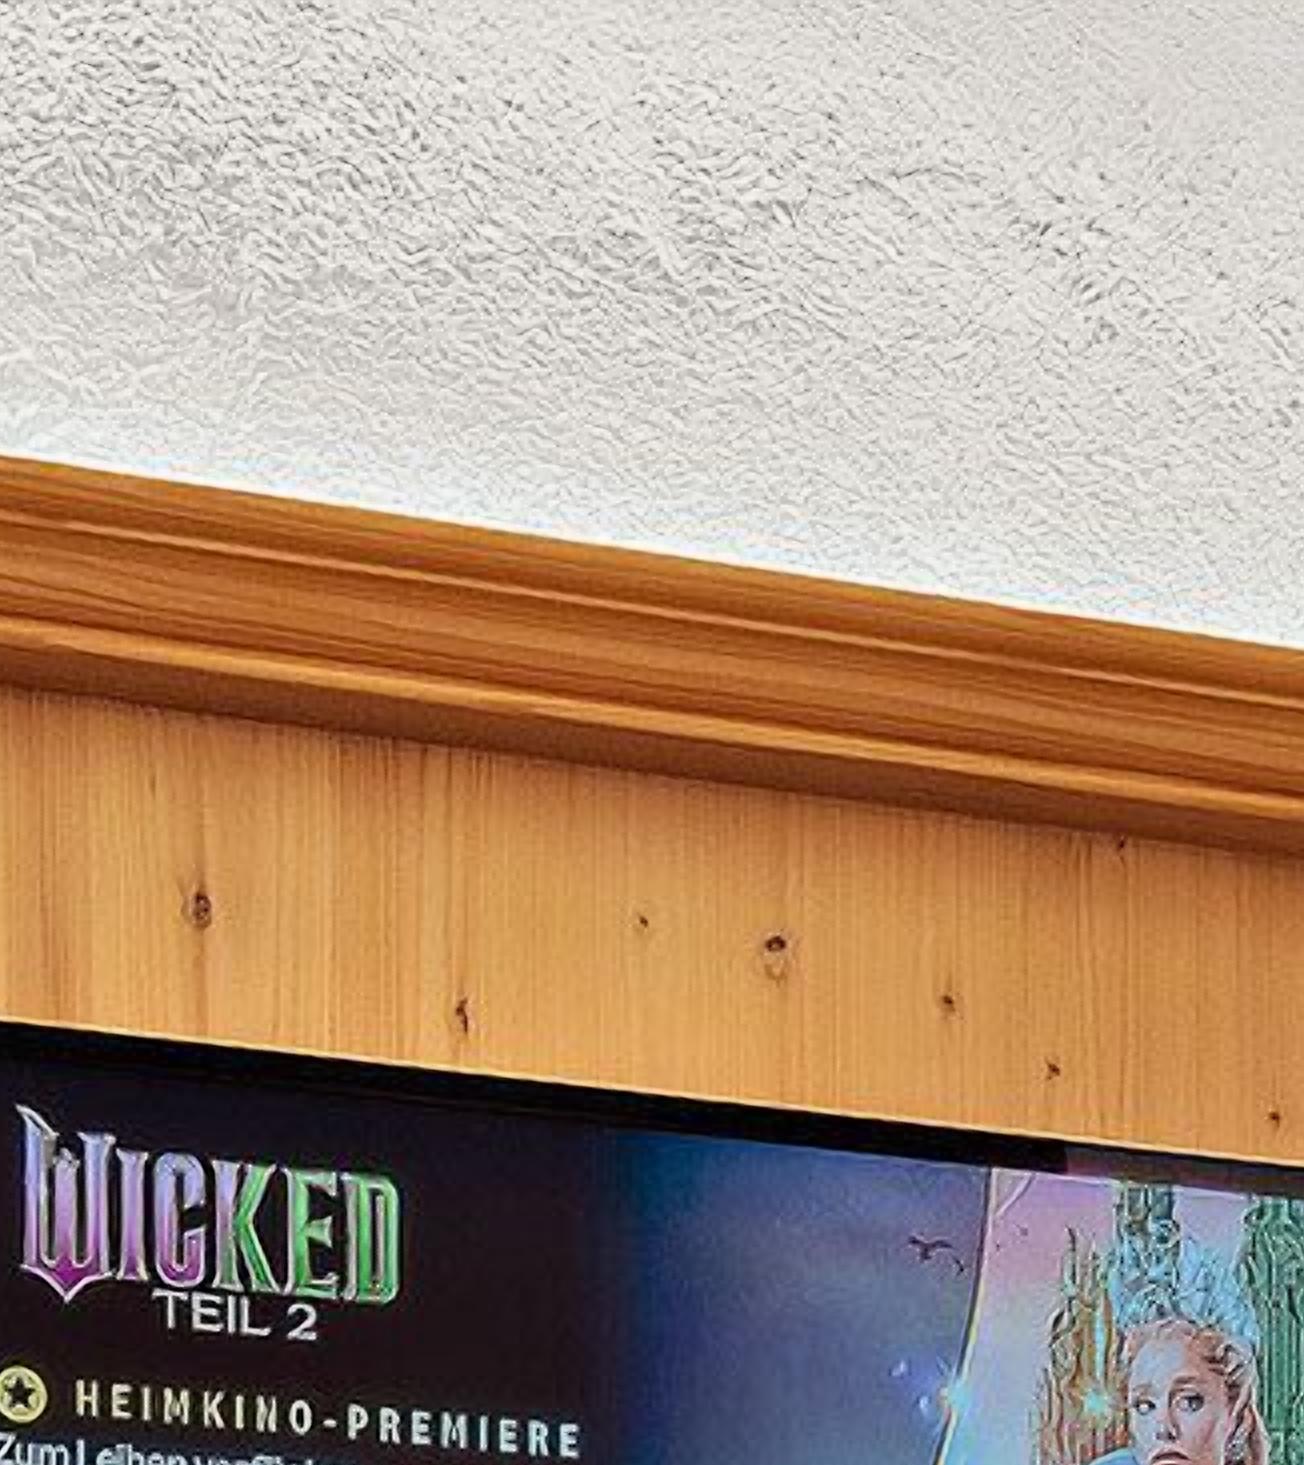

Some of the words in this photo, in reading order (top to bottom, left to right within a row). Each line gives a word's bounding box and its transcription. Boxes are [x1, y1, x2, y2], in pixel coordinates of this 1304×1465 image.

[15, 1103, 399, 1304] WICKED
[152, 1288, 272, 1337] TEIL
[286, 1303, 318, 1342] 2
[74, 1378, 582, 1460] HEIMKINO-PREMIERE
